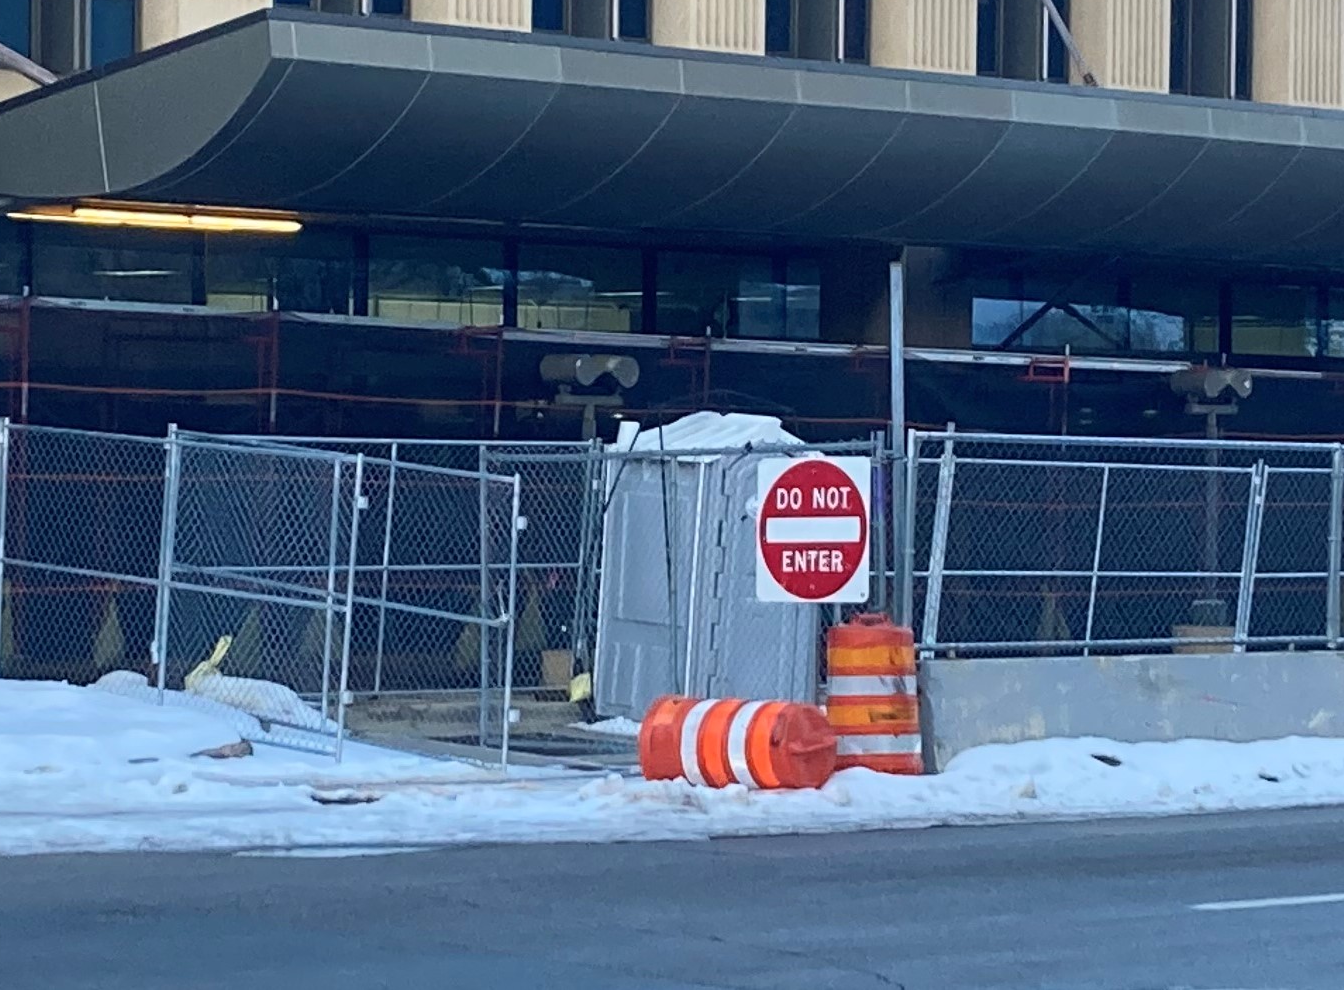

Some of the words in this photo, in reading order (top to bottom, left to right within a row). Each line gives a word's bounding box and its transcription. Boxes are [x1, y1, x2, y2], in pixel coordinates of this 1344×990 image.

[776, 487, 803, 510] DO
[812, 486, 852, 510] NOT
[782, 549, 845, 573] ENTER
